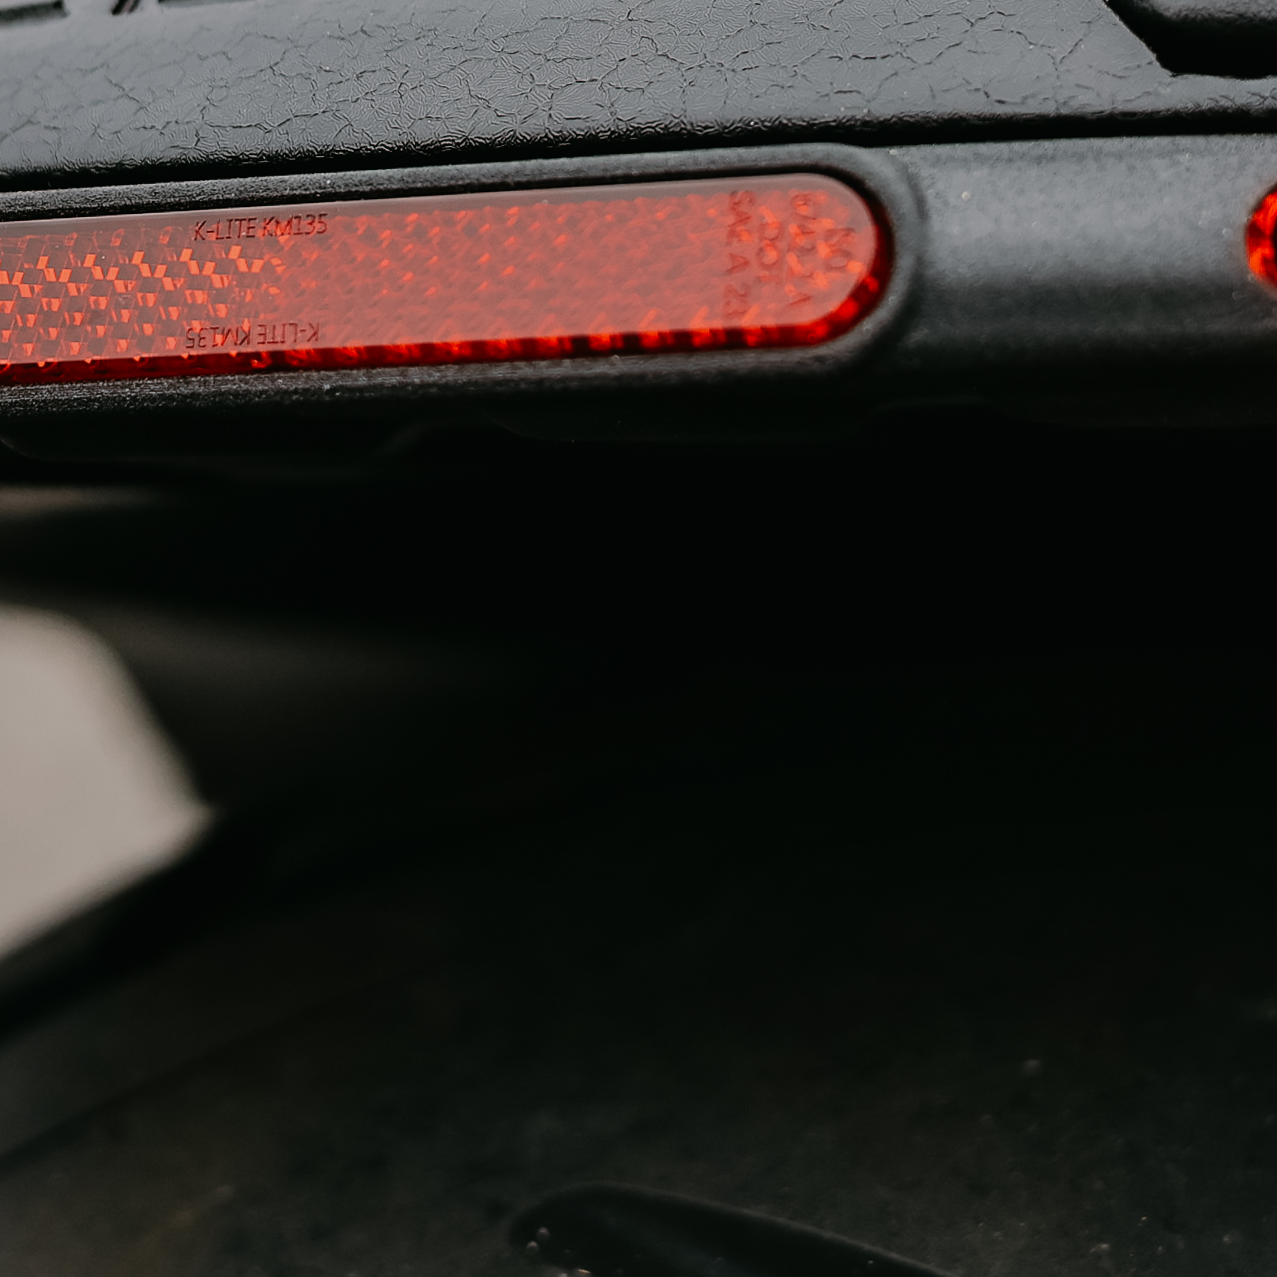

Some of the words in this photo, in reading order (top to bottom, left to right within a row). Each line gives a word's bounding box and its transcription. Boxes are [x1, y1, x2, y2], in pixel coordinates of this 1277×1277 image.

[194, 217, 257, 241] K-LITE
[262, 213, 328, 238] KM135
[186, 325, 251, 349] KM135
[257, 322, 320, 345] K-LITE
